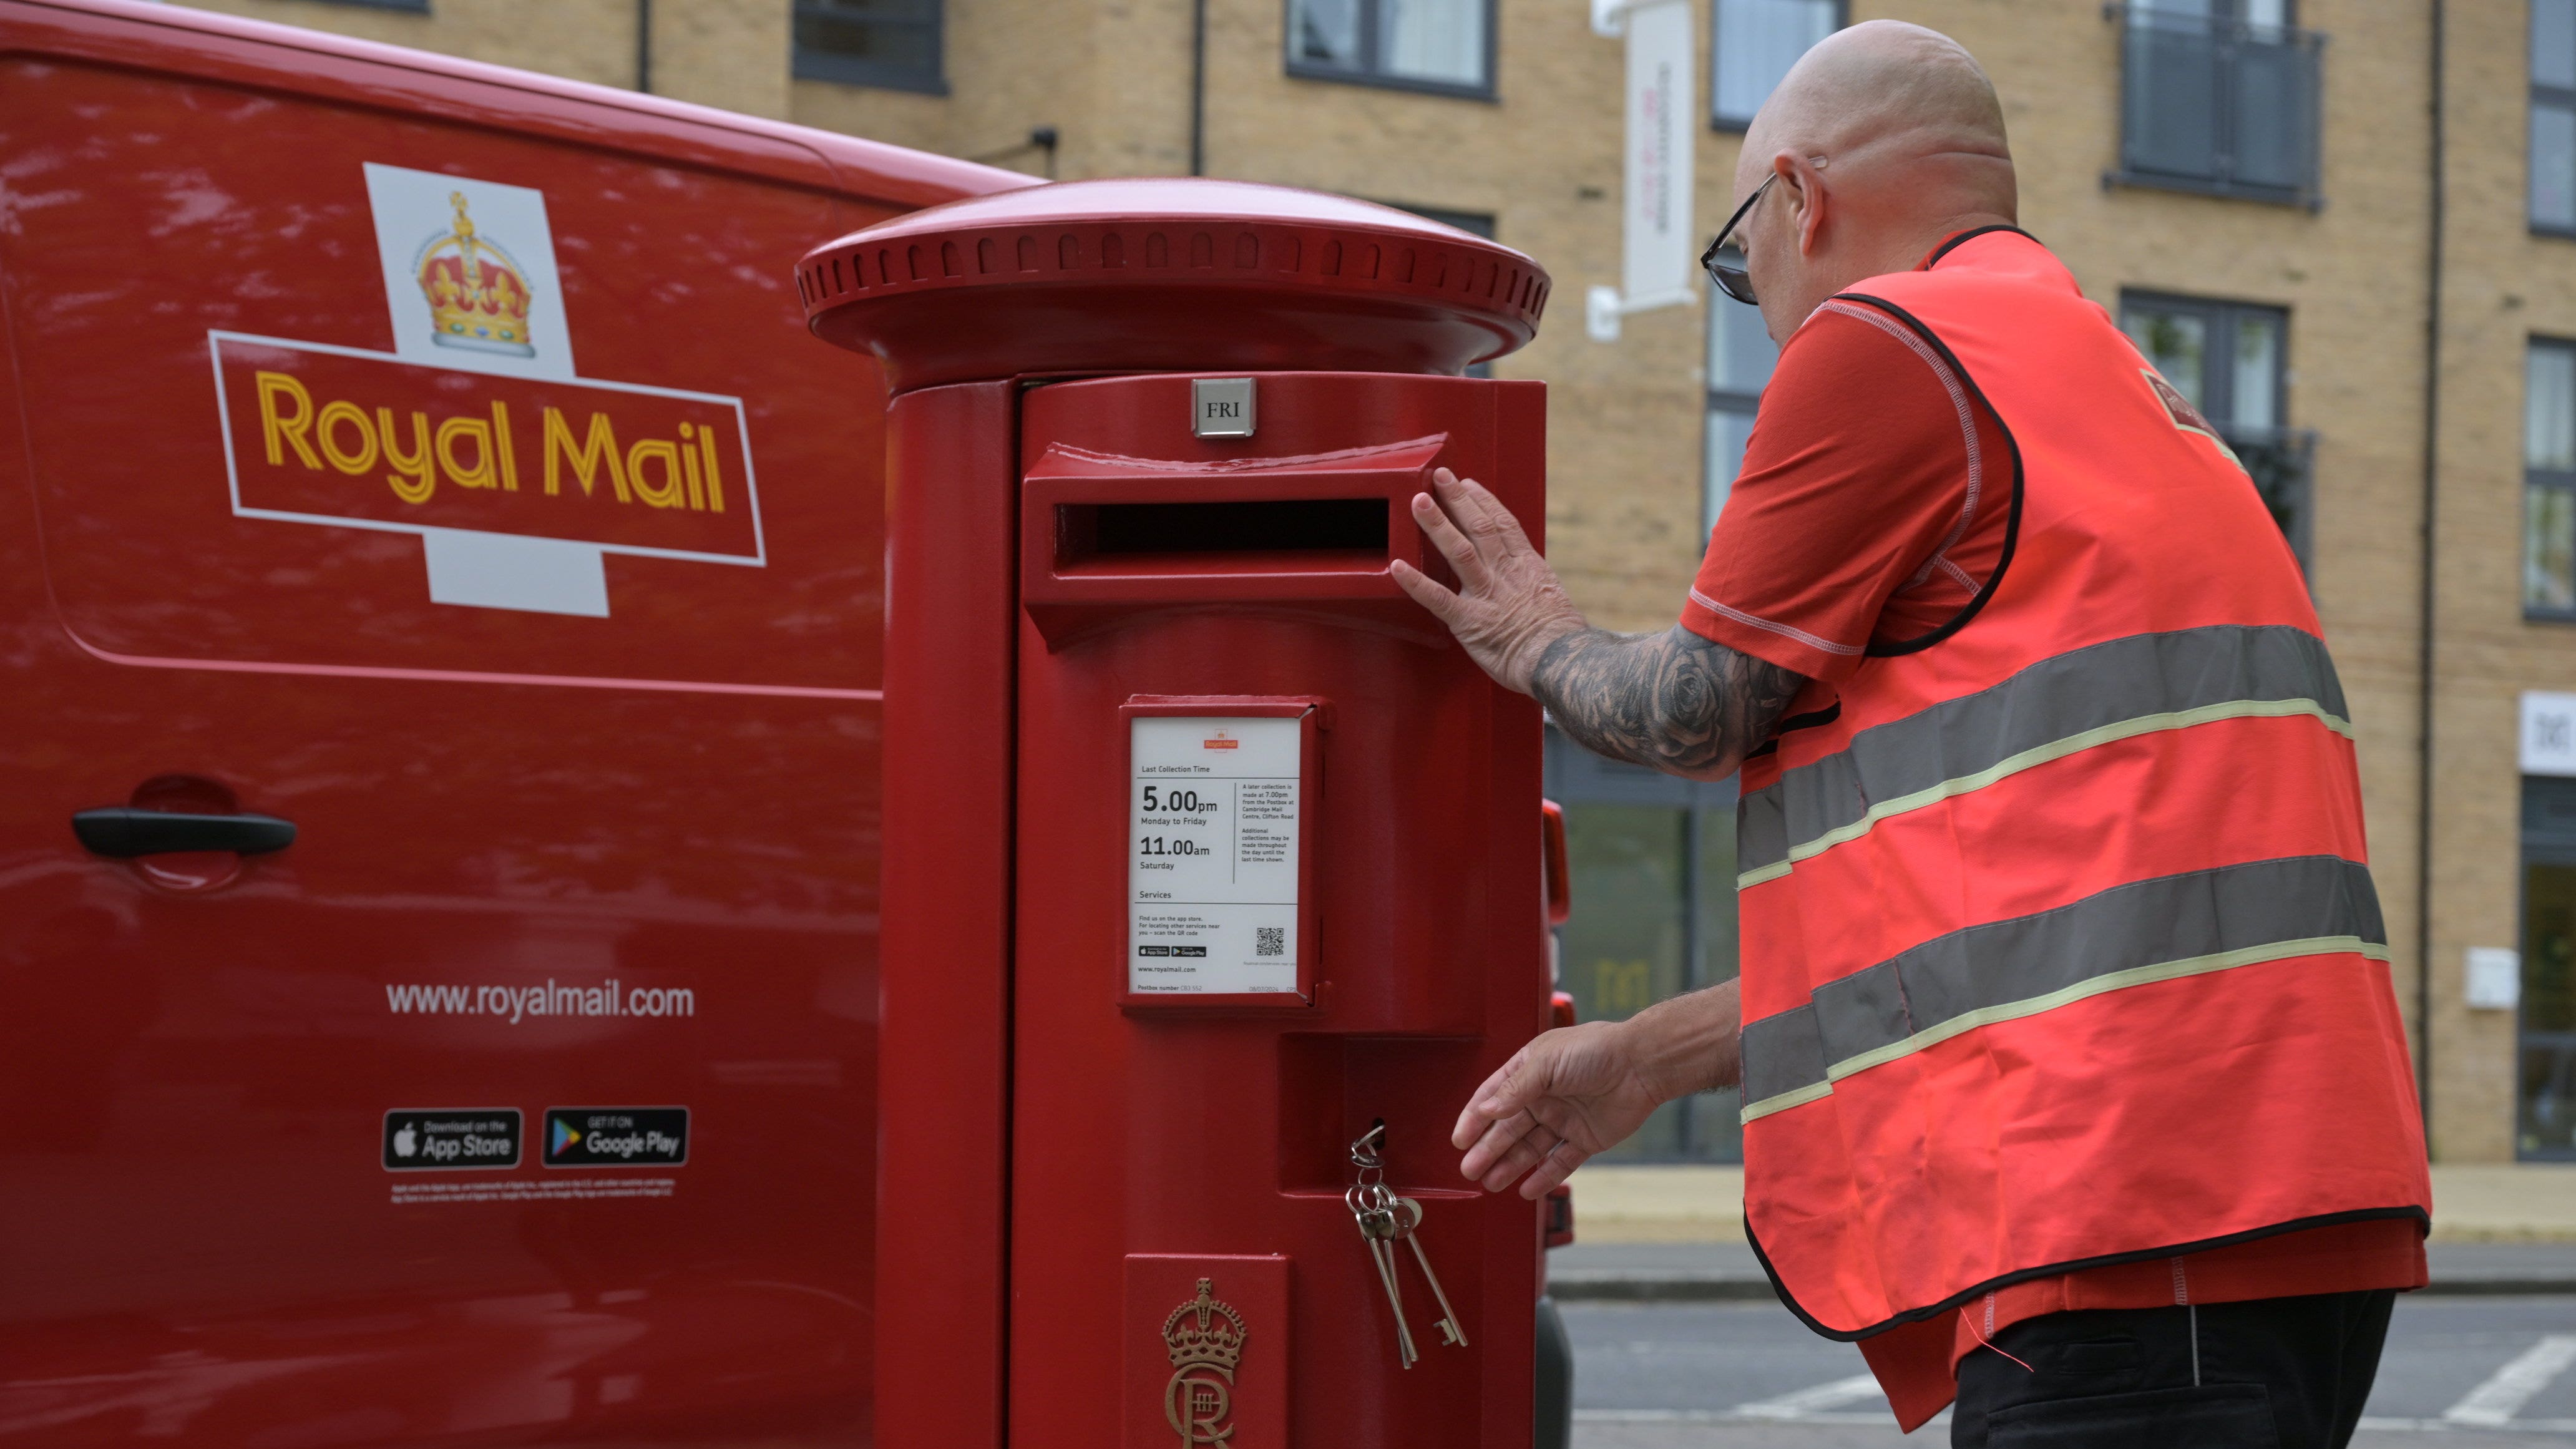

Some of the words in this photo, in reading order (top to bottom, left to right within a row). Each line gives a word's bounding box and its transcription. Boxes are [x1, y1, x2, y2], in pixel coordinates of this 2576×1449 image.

[1206, 402, 1240, 418] FRI
[256, 371, 518, 504] Royal
[544, 407, 724, 513] Mail
[1143, 786, 1217, 814] 5.00pm
[1141, 817, 1170, 826] Monday
[1183, 817, 1207, 826] Friday
[1141, 837, 1209, 855] 11.00am
[1140, 862, 1174, 871] Saturday
[385, 978, 694, 1025] www.royalmail.com
[423, 1121, 472, 1134] Download
[474, 1123, 487, 1133] on
[489, 1121, 507, 1133] the
[421, 1134, 462, 1161] App
[462, 1133, 512, 1158] Store
[585, 1130, 645, 1159] Google
[645, 1129, 681, 1158] Play
